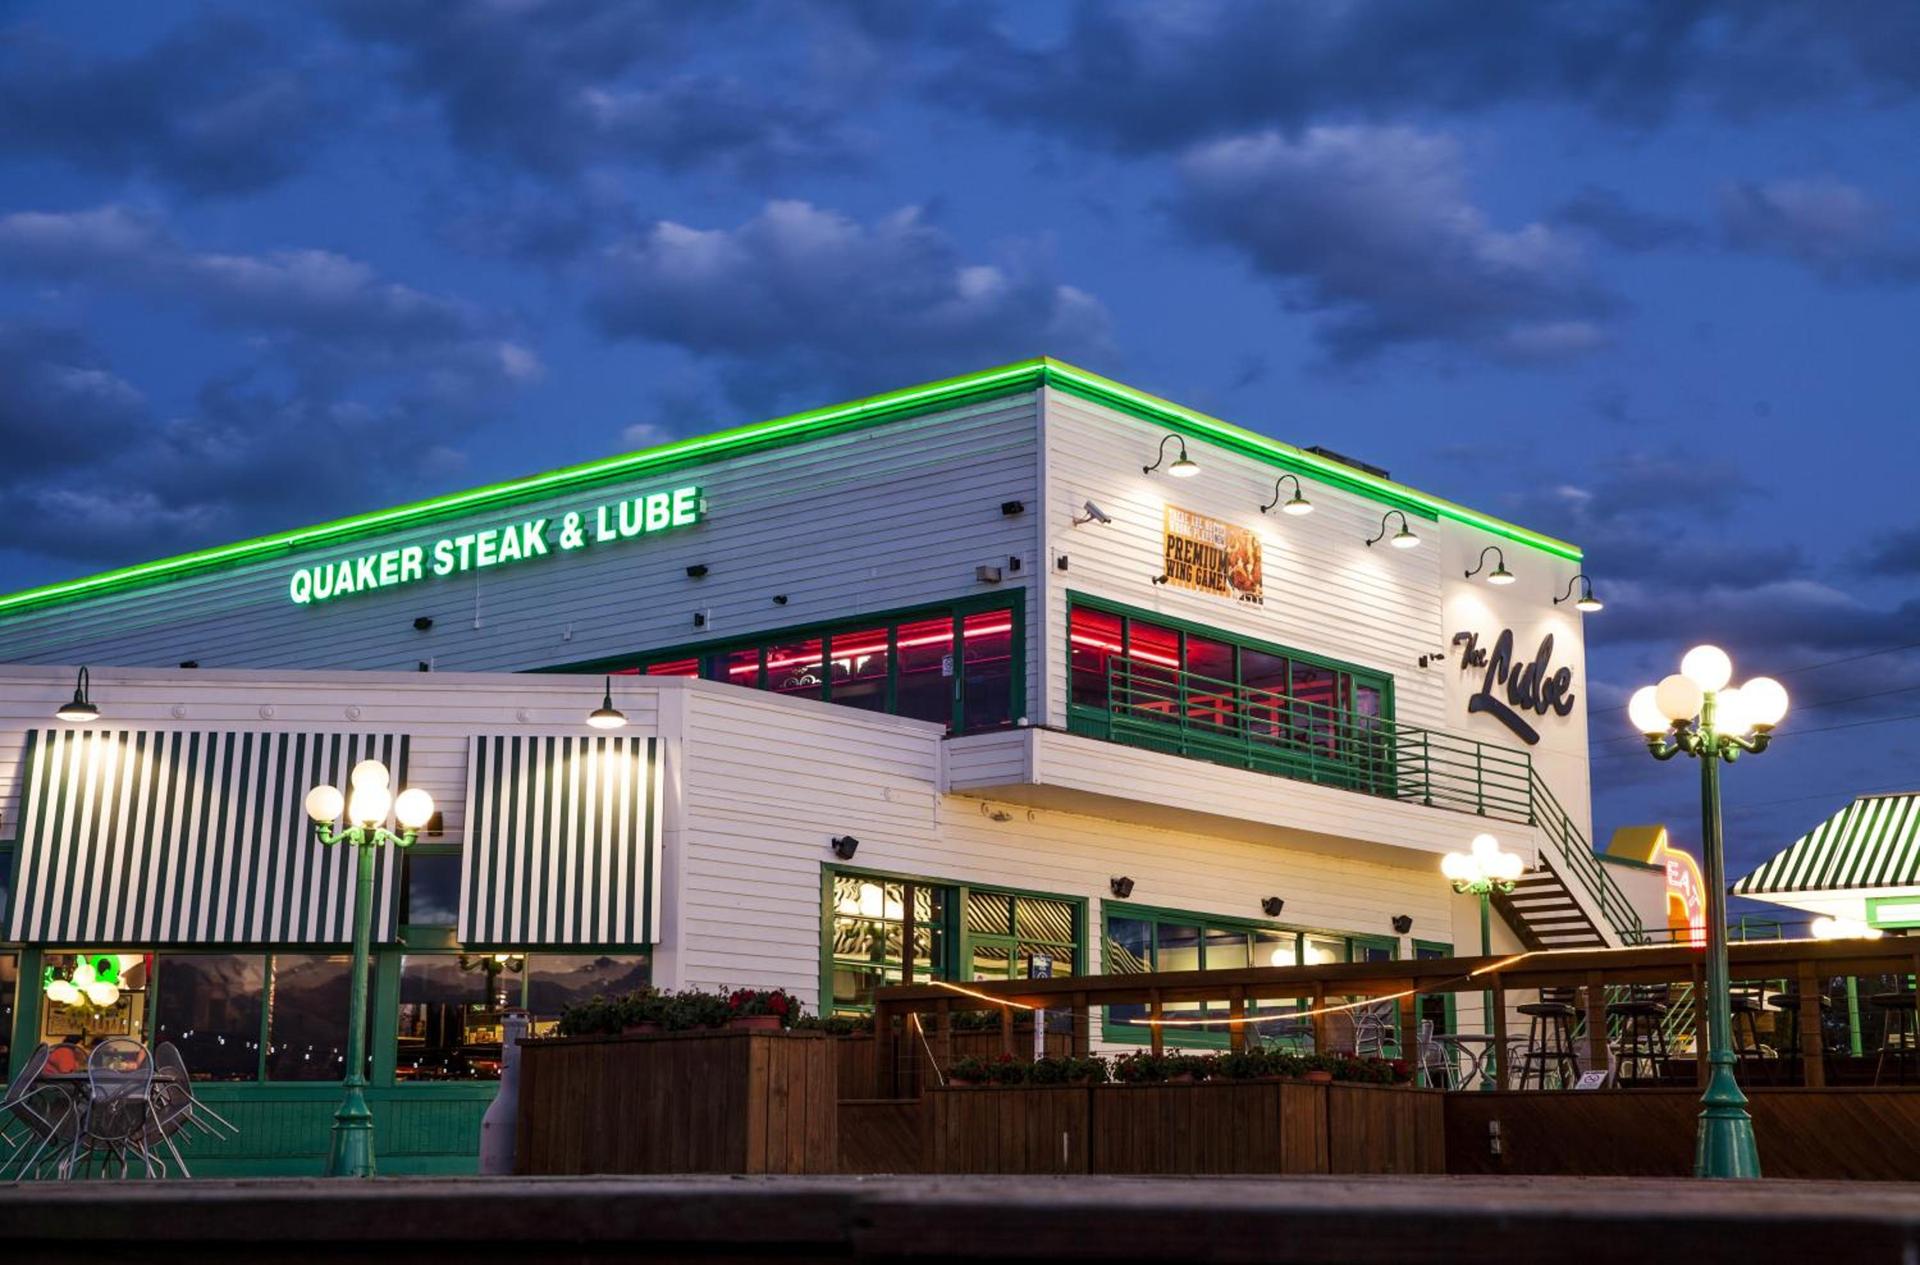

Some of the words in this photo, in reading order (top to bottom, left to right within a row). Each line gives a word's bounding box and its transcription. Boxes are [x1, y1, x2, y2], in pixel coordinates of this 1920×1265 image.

[290, 545, 426, 604] QUAKER
[433, 519, 552, 576] STEAK
[559, 511, 585, 549] &
[597, 486, 702, 543] LUBE
[1166, 534, 1228, 575] PREMIUM
[1166, 559, 1193, 583] WING
[1452, 631, 1488, 670] The
[1468, 629, 1575, 745] Lube
